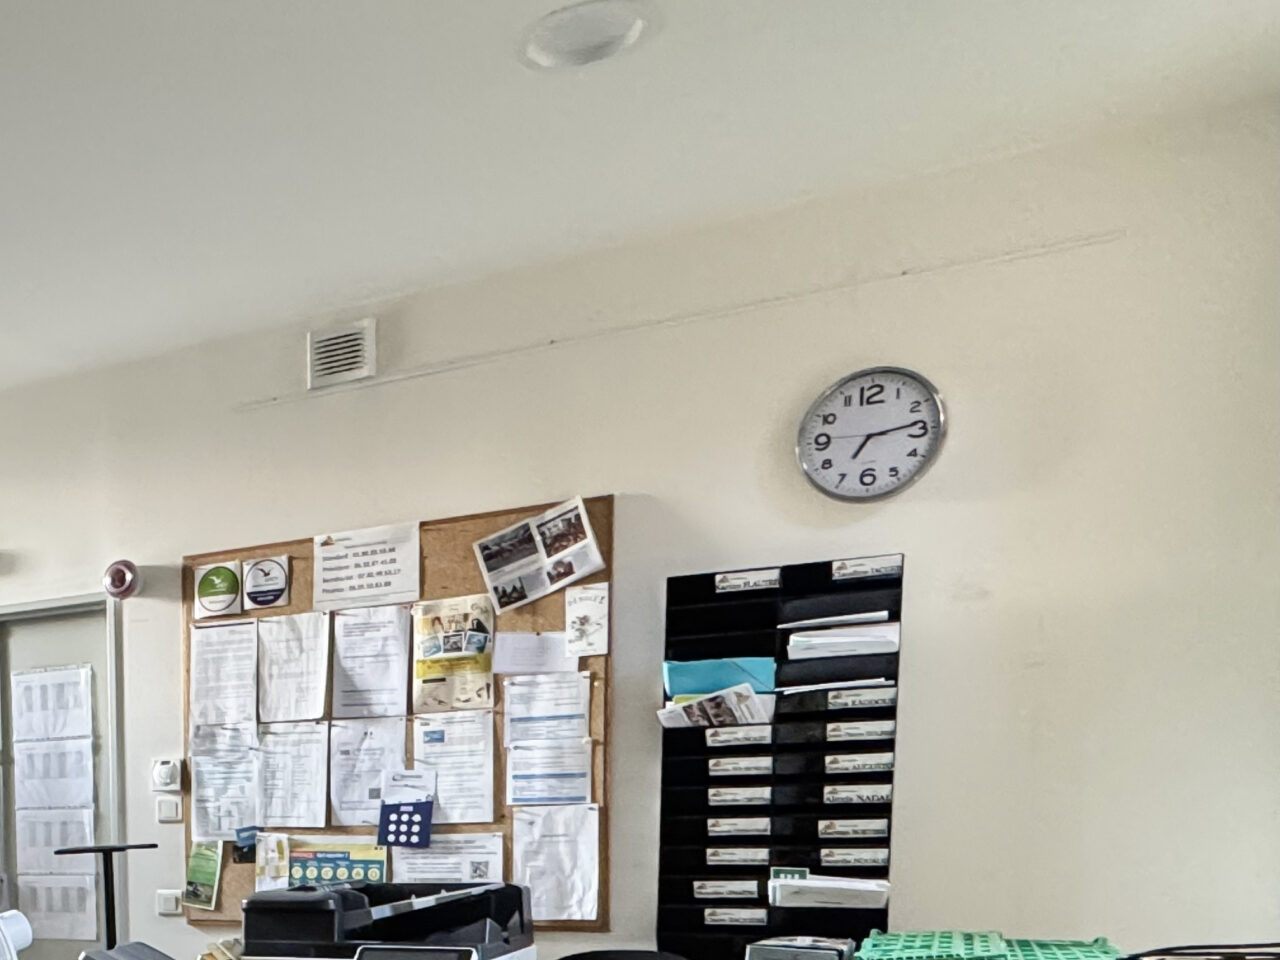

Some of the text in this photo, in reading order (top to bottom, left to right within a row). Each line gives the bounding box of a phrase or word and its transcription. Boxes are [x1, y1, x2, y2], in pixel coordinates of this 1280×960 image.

[860, 384, 885, 407] 12
[895, 387, 901, 399] 1
[844, 394, 852, 407] 11
[909, 400, 922, 413] 2
[822, 413, 837, 426] 10
[907, 420, 928, 438] 3
[814, 433, 831, 451] 9
[906, 448, 918, 458] 4
[821, 458, 833, 470] 8
[859, 468, 876, 486] 6
[889, 466, 899, 478] 5
[834, 473, 847, 489] 7
